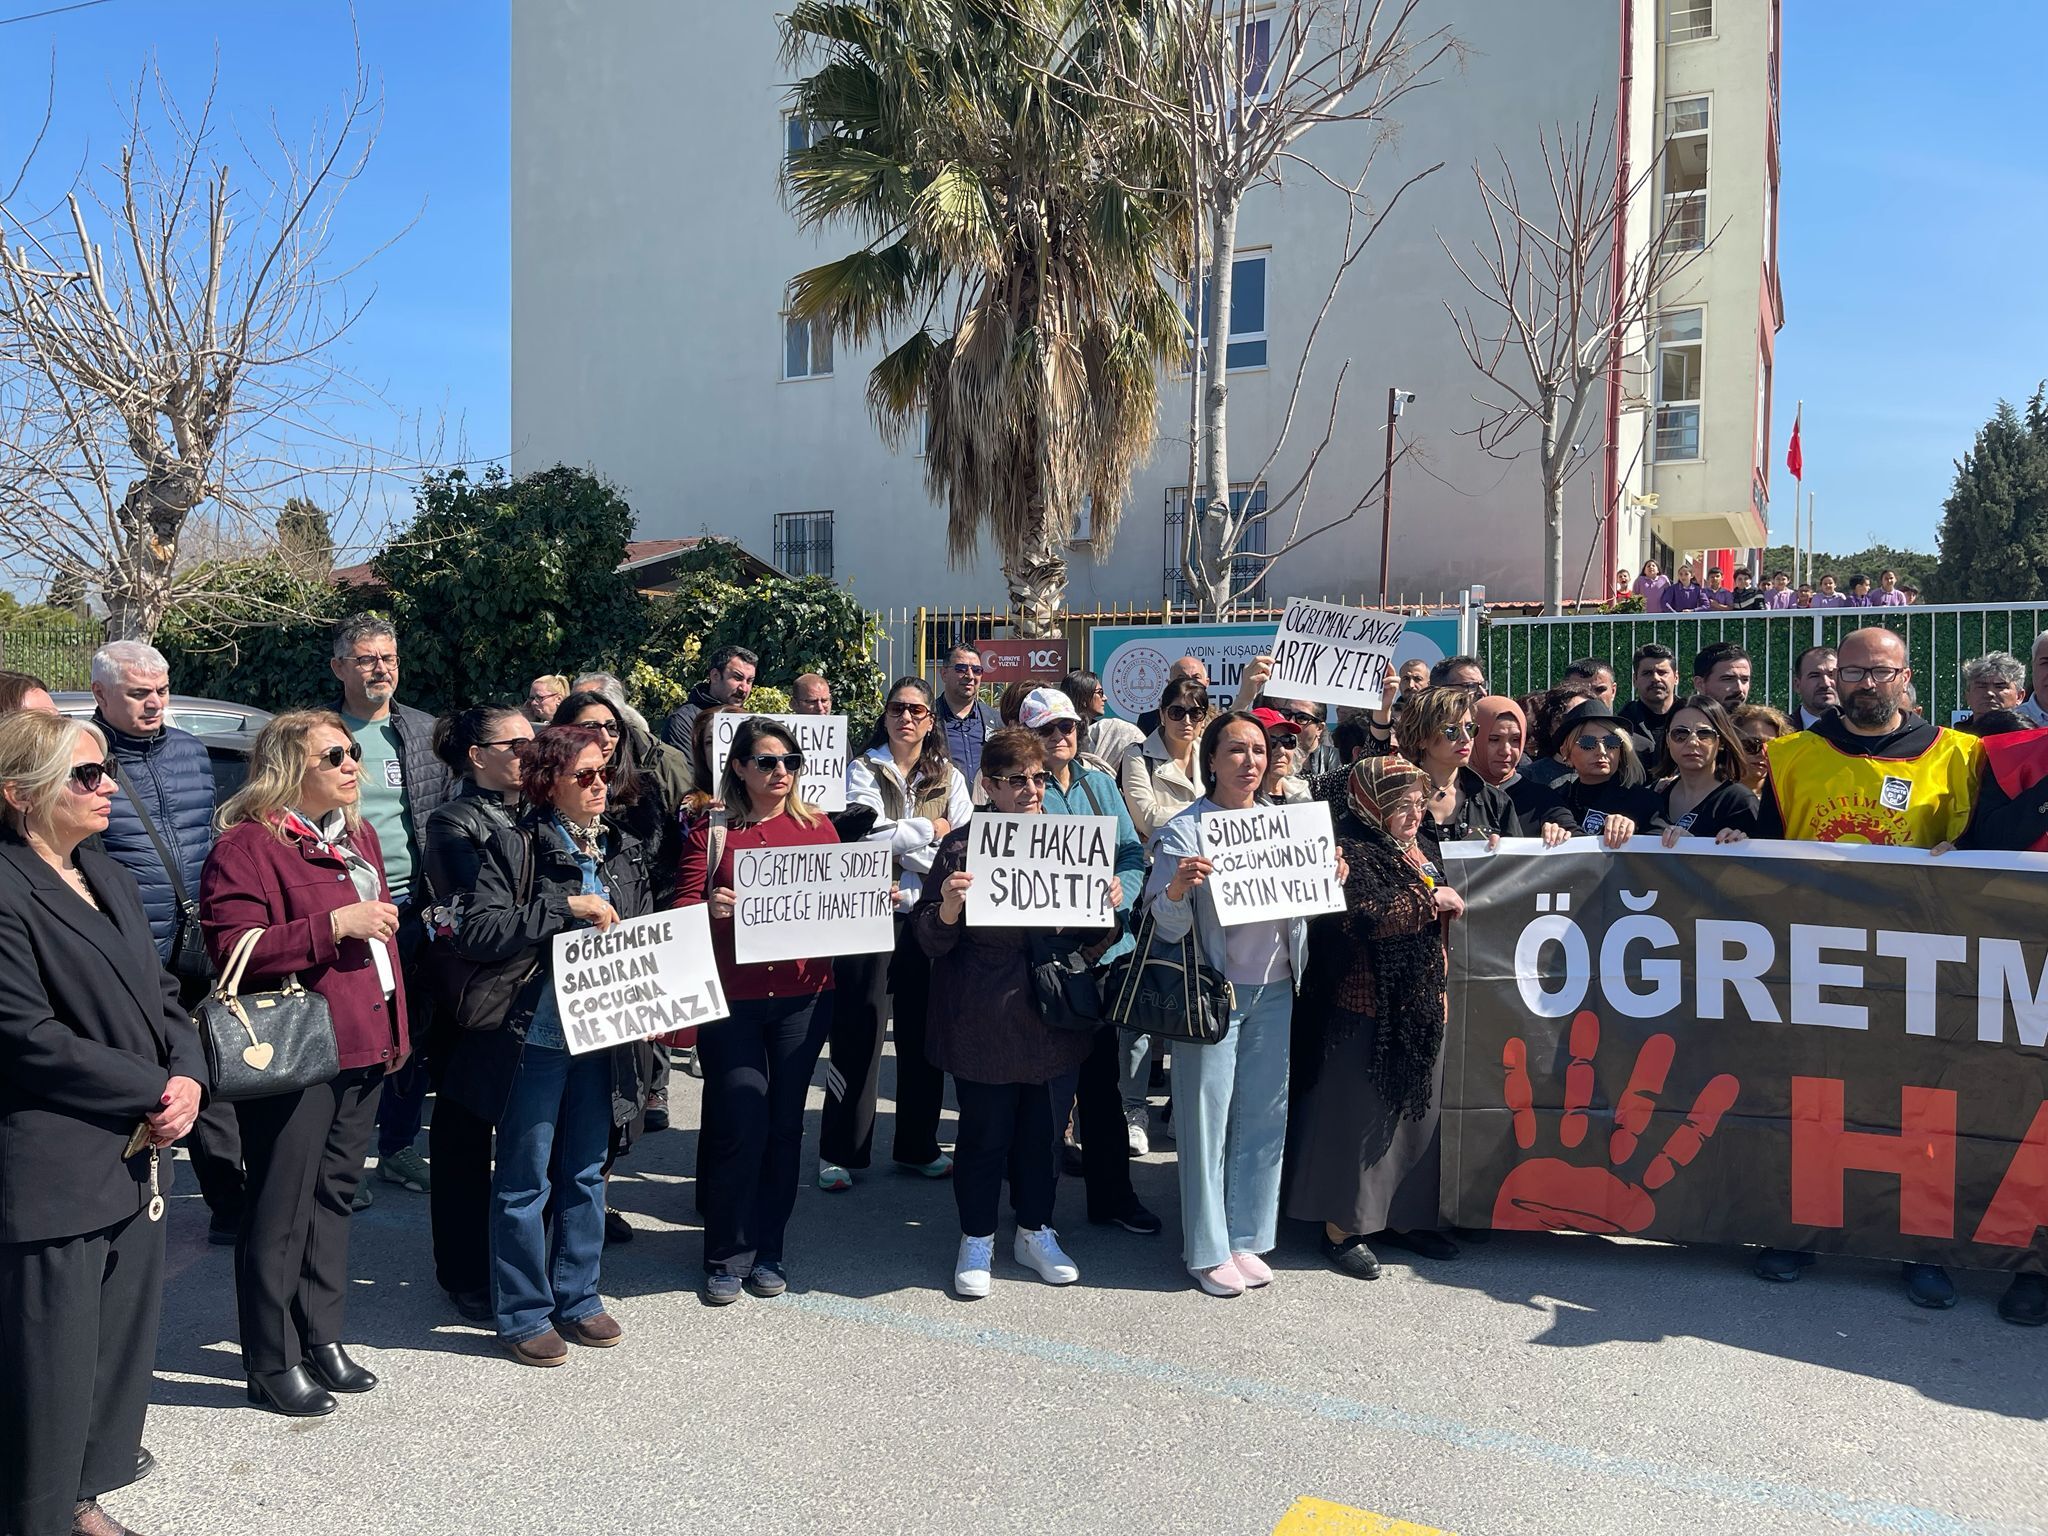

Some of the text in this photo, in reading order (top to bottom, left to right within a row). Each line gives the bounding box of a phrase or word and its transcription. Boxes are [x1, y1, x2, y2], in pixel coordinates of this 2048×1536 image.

[1185, 646, 1214, 657] AYDIN
[1224, 644, 1272, 659] KUŞADAS
[1269, 640, 1390, 694] ARTIK YETER!
[1809, 793, 1877, 831] EĞİTİM
[980, 821, 1110, 867] NE HAKLA
[738, 850, 833, 888] ÖĞRETMENE
[741, 890, 813, 927] GELECEĞE
[1222, 876, 1278, 907] SAYIN
[565, 922, 673, 964] ÖĞRETMENE
[562, 952, 660, 994] SALDIRAN
[1513, 889, 2048, 1048] ÖĞRETM
[1140, 989, 1178, 1010] FILA
[571, 1018, 607, 1047] NE
